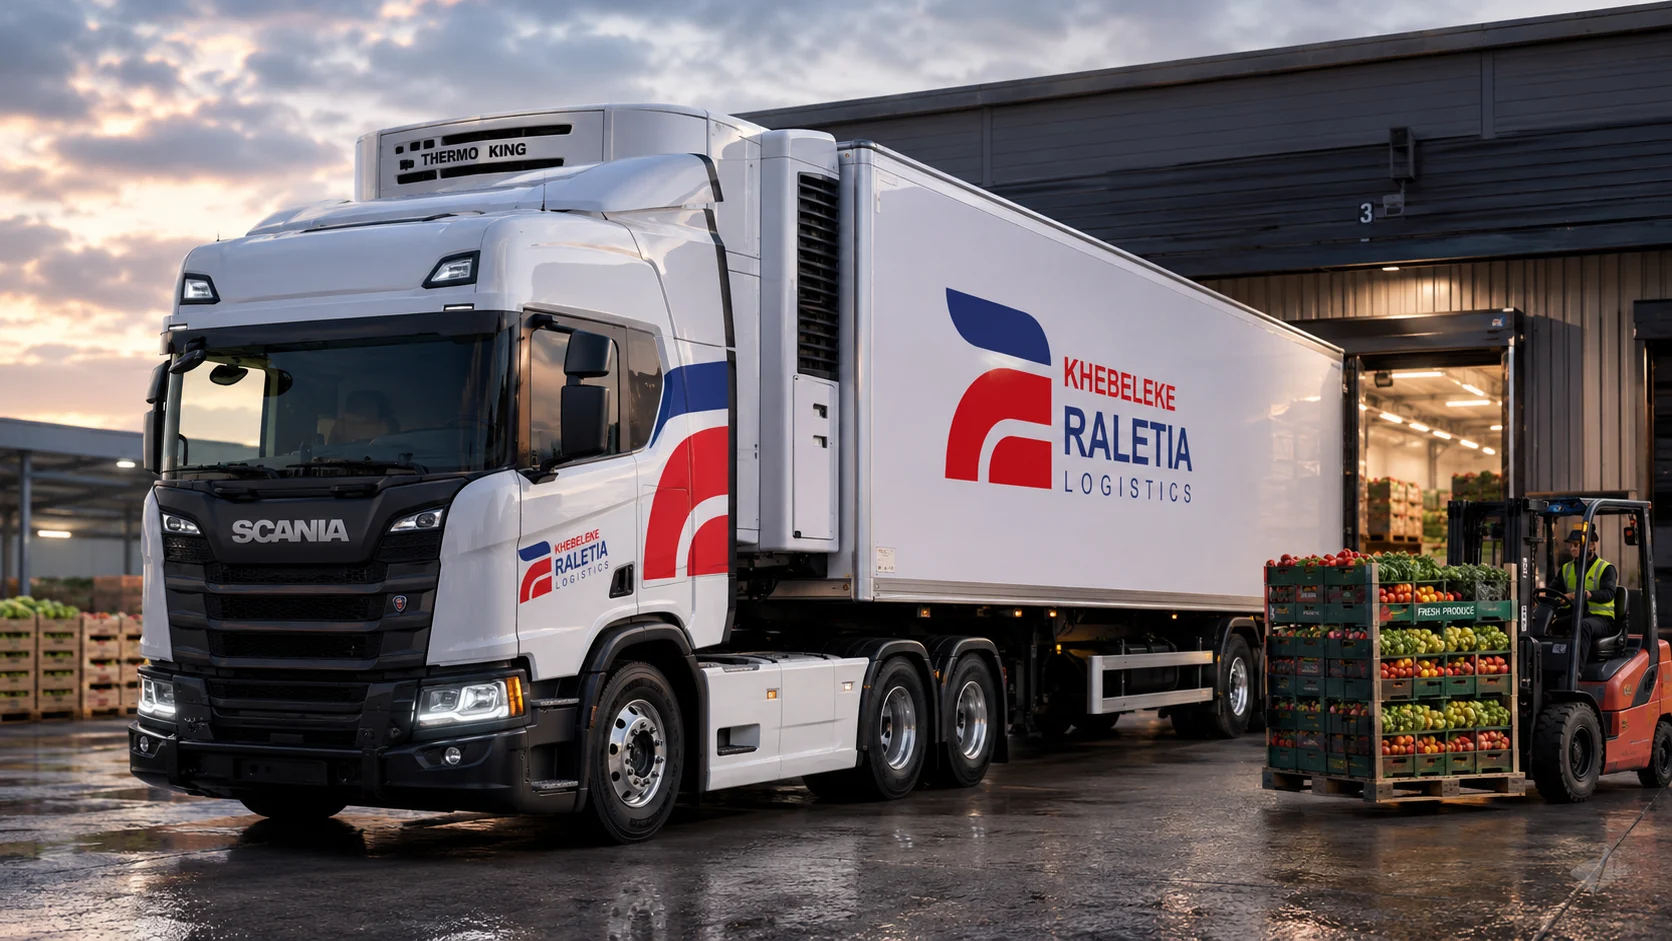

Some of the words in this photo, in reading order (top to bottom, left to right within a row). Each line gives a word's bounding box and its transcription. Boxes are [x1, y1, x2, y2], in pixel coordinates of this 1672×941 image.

[421, 147, 479, 166] THERMO
[488, 142, 527, 158] KING
[1360, 203, 1373, 224] 3
[1064, 356, 1176, 412] KHEBELEKE
[1064, 405, 1193, 472] RALETIA
[1064, 470, 1192, 504] LOGISTICS
[231, 519, 350, 544] SCANIA
[555, 540, 608, 576] RALETIA
[555, 560, 609, 590] LOGISTICS
[1417, 607, 1441, 617] FRESH
[1442, 605, 1475, 615] PRODUCE
